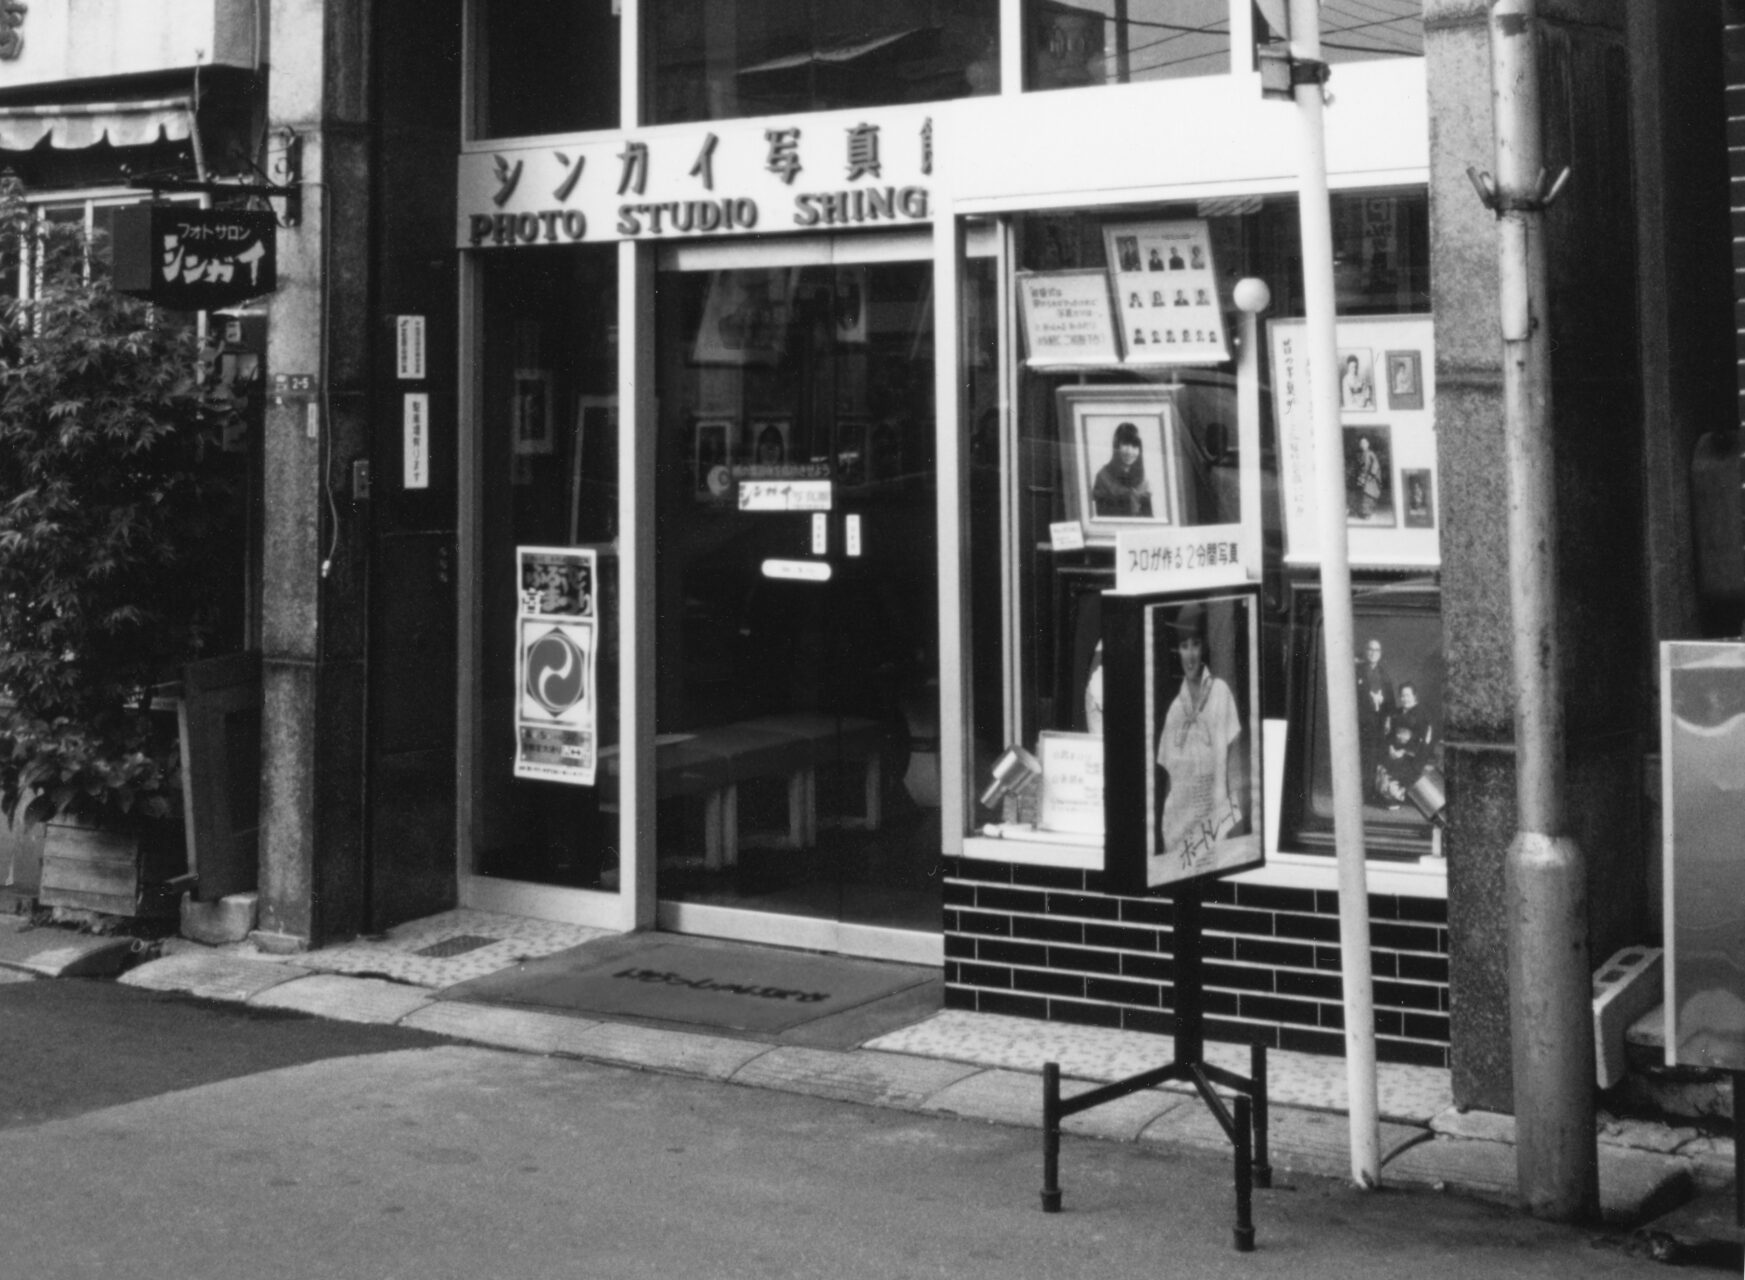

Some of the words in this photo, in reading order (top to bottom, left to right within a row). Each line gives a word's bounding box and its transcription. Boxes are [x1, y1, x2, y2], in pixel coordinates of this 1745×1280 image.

[470, 210, 587, 245] PHOTO
[617, 197, 759, 235] STUDIO
[162, 234, 265, 286] シンガイ
